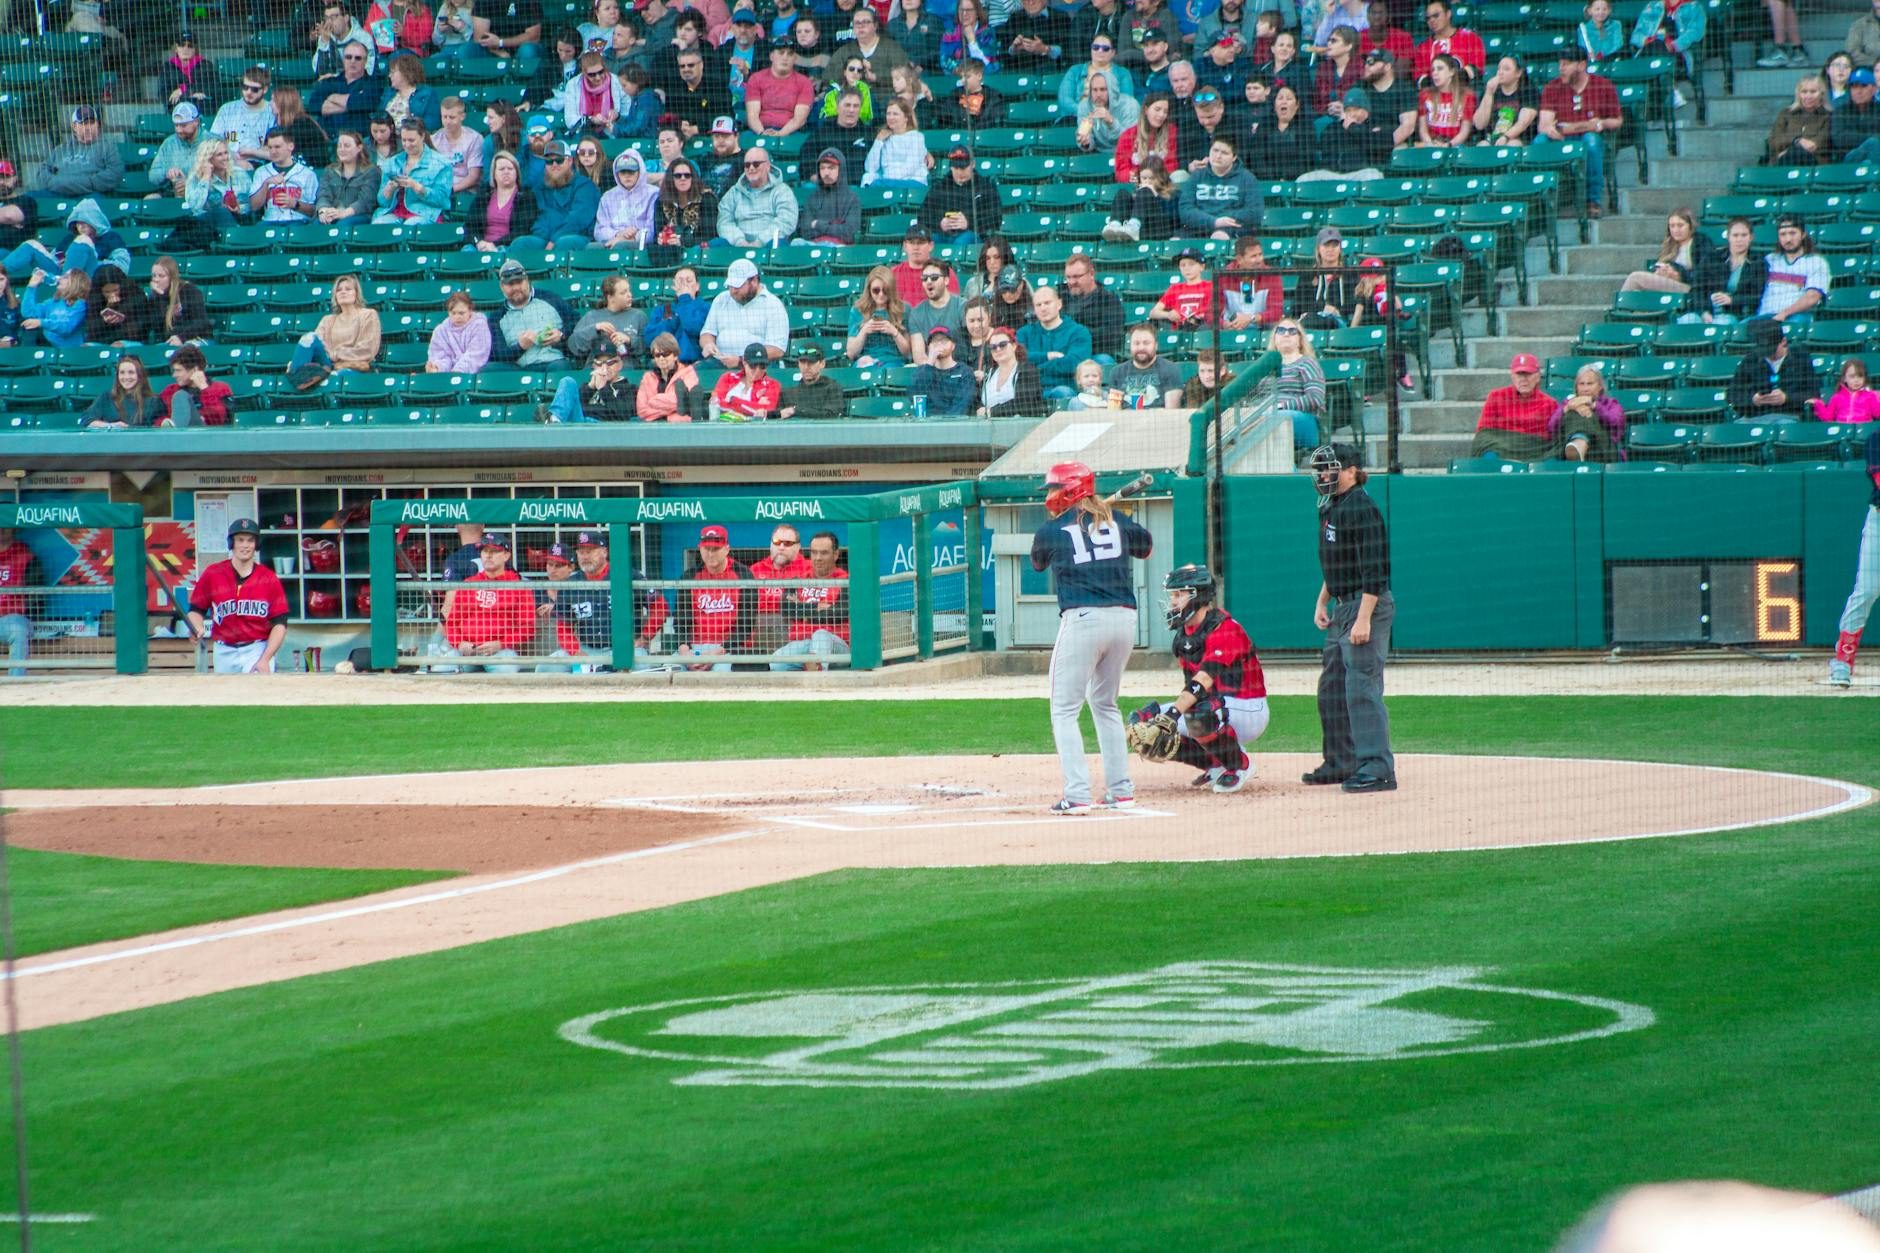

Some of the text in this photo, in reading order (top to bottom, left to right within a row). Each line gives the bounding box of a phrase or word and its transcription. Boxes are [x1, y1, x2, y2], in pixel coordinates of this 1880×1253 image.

[199, 475, 257, 484] INDYINDIANS.COM
[325, 474, 384, 483] INDYINDIANS.COM
[474, 472, 533, 481] INDYINDIANS.COM
[624, 470, 683, 480] INDYINDIANS.COM
[799, 468, 859, 478] INDYINDIANS.COM
[899, 493, 922, 514] AQUAFINA
[938, 486, 962, 508] AQUAFINA
[15, 506, 83, 525] AQUAFINA
[401, 501, 470, 521] AQUAFINA
[519, 501, 588, 521] AQUAFINA
[636, 500, 707, 520] AQUAFINA
[755, 499, 825, 519] AQUAFINA
[1061, 520, 1122, 564] 19
[697, 594, 735, 614] Reds
[1757, 563, 1800, 641] 6
